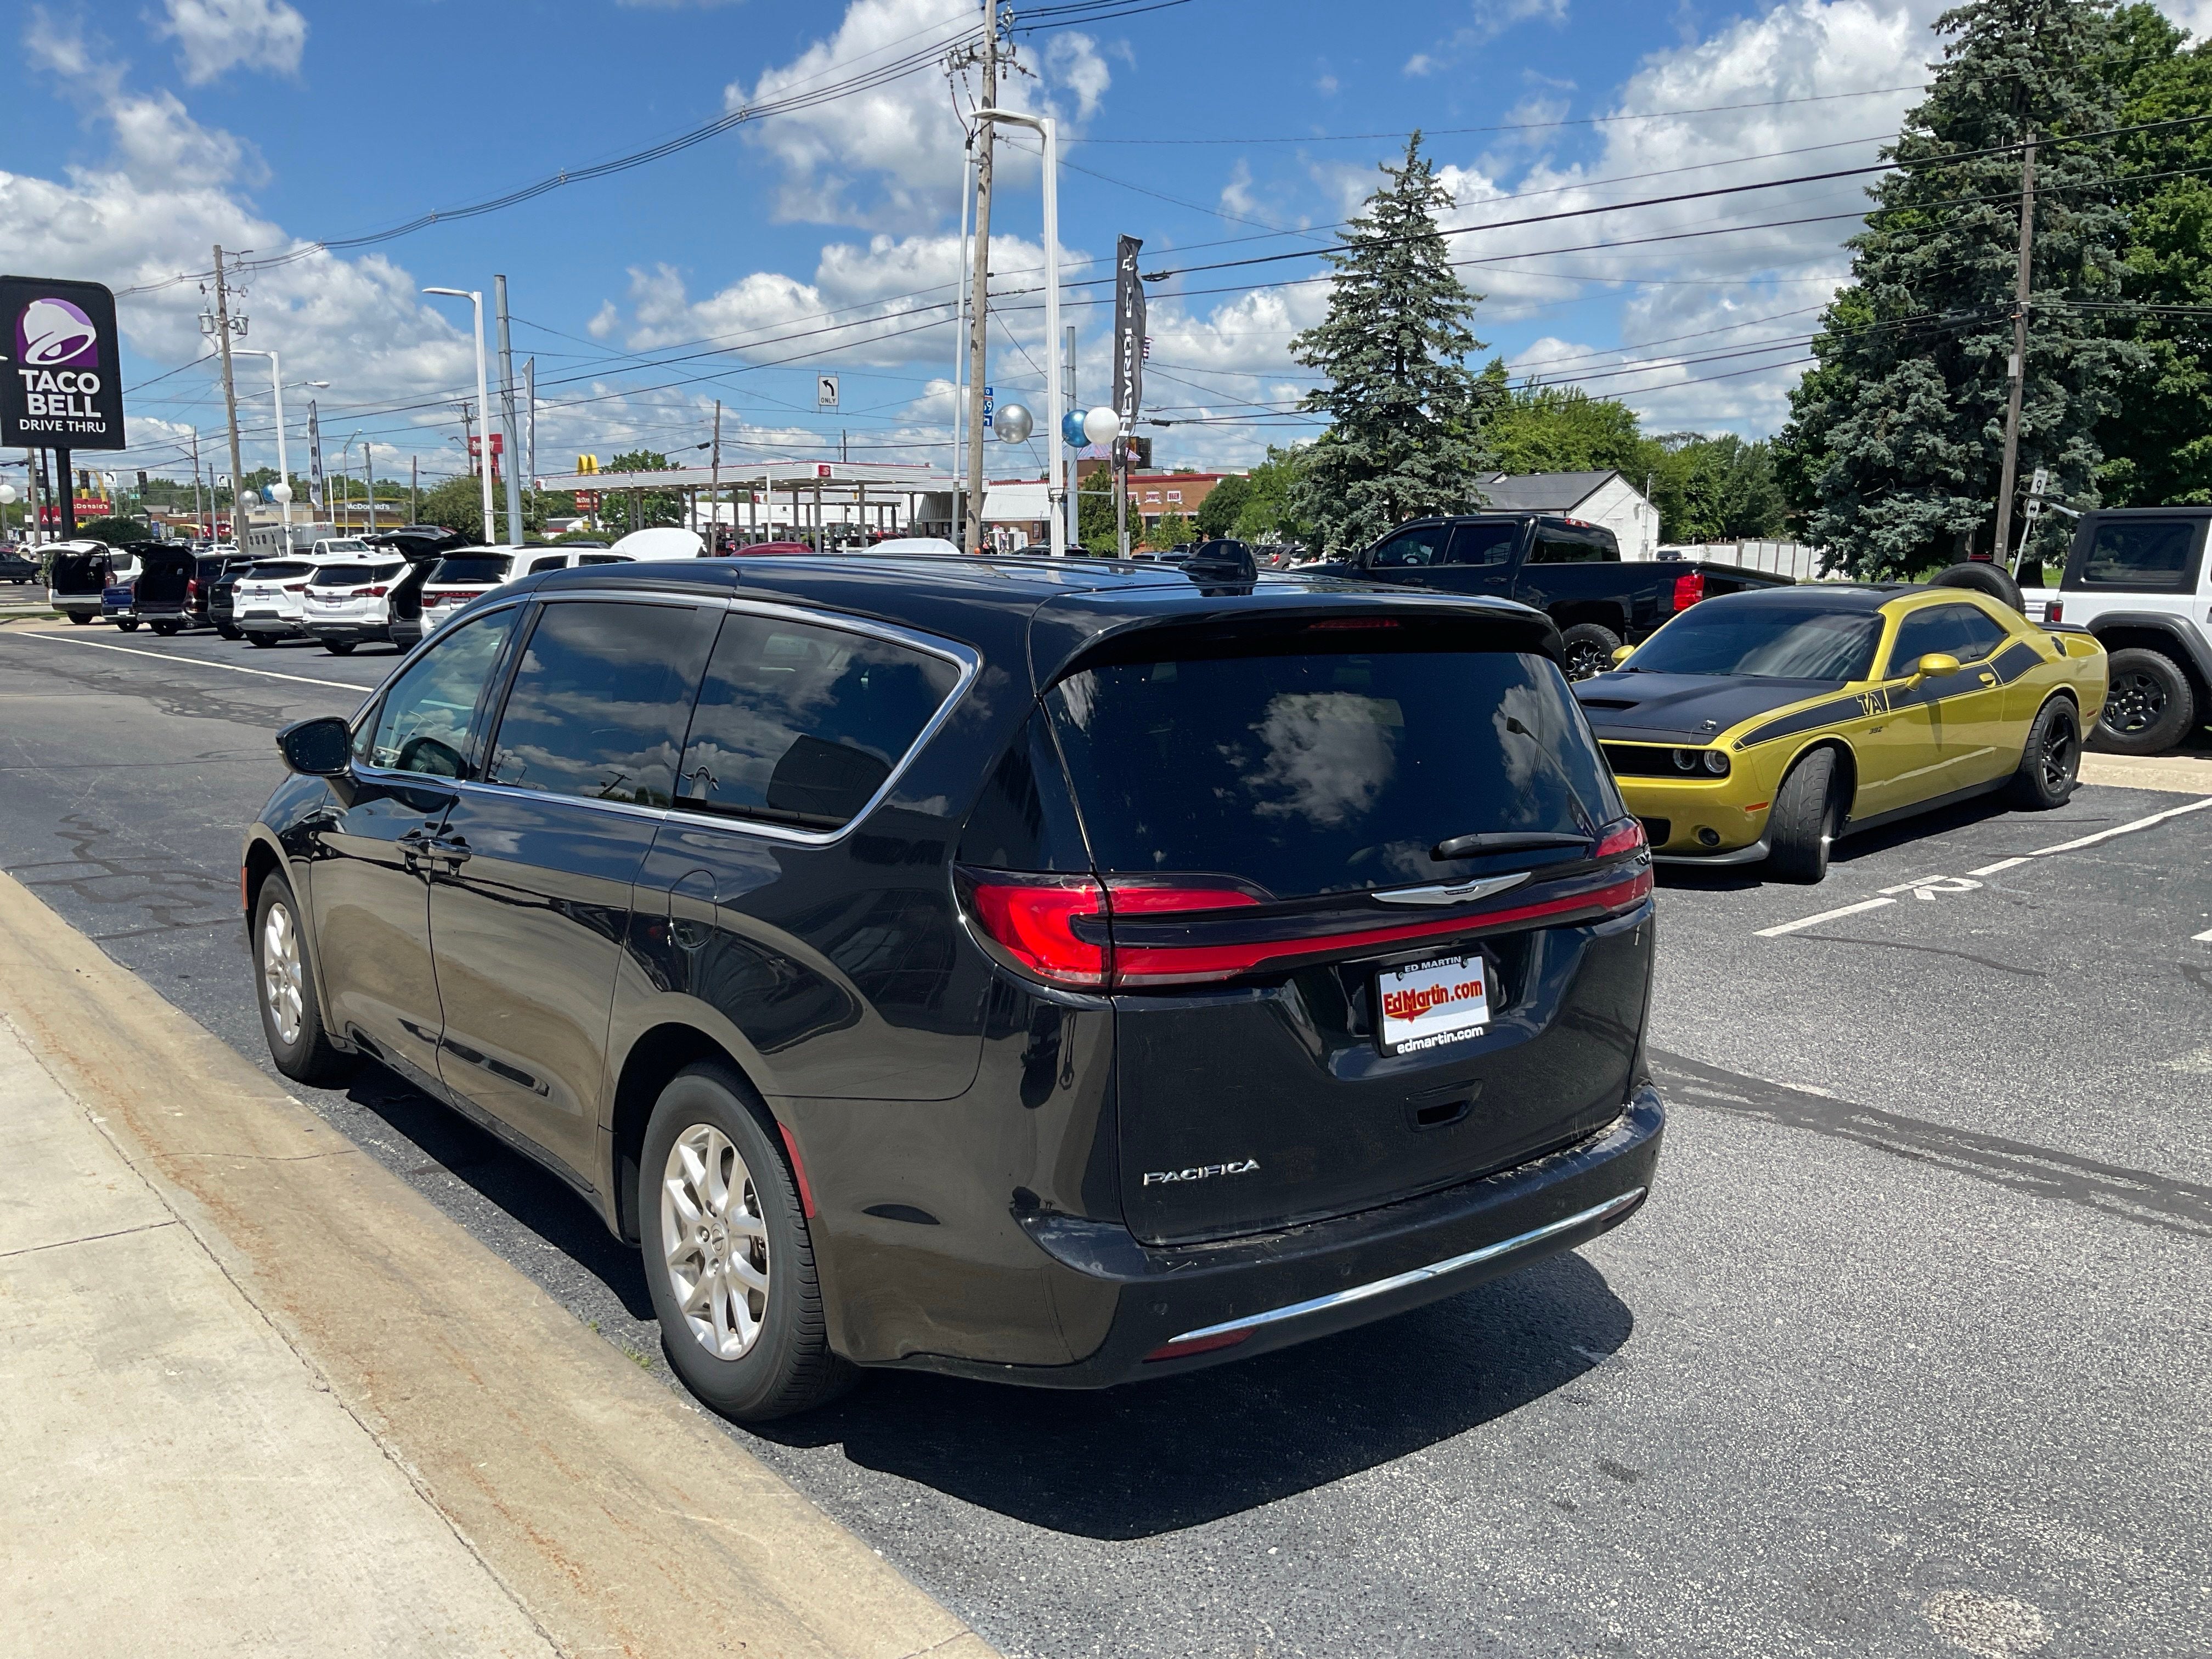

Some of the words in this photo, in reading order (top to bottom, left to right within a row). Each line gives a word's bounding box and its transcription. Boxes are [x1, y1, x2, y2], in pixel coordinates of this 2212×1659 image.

[18, 369, 100, 394] TACO
[27, 393, 101, 417] BELL
[19, 419, 63, 431] DRIVE
[66, 420, 106, 432] THRU
[2037, 479, 2042, 493] 9
[1869, 726, 1883, 735] 392
[1404, 964, 1419, 973] ED
[1421, 956, 1462, 969] MARTIN
[1383, 980, 1483, 1014] EdMartin.com
[1397, 1026, 1483, 1054] edmartin.com
[1143, 1158, 1260, 1186] PACIFICA
